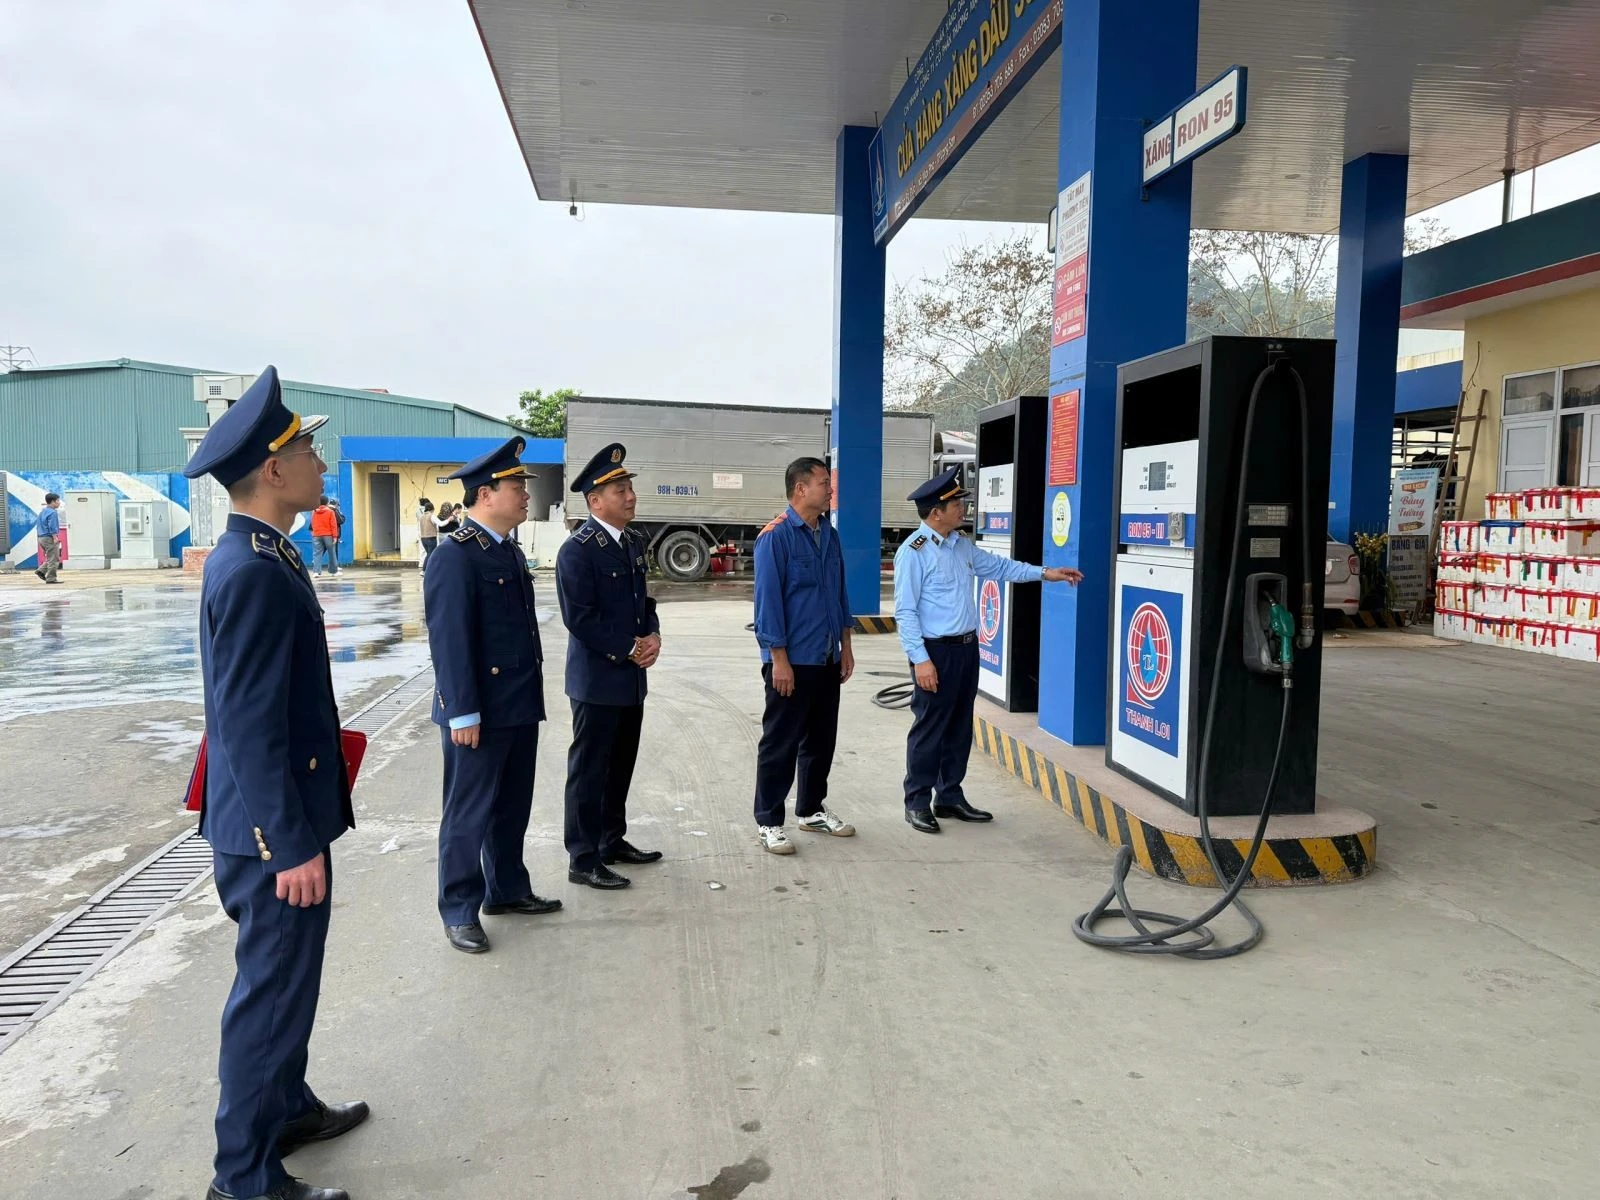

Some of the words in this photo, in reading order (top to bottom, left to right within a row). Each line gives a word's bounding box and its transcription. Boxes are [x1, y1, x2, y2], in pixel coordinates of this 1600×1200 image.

[897, 122, 915, 178] CỬA
[915, 89, 942, 154] HÀNG
[944, 39, 978, 118] XĂNG
[1145, 133, 1171, 169] XĂNG
[1177, 108, 1209, 148] RON
[1213, 91, 1233, 124] 95
